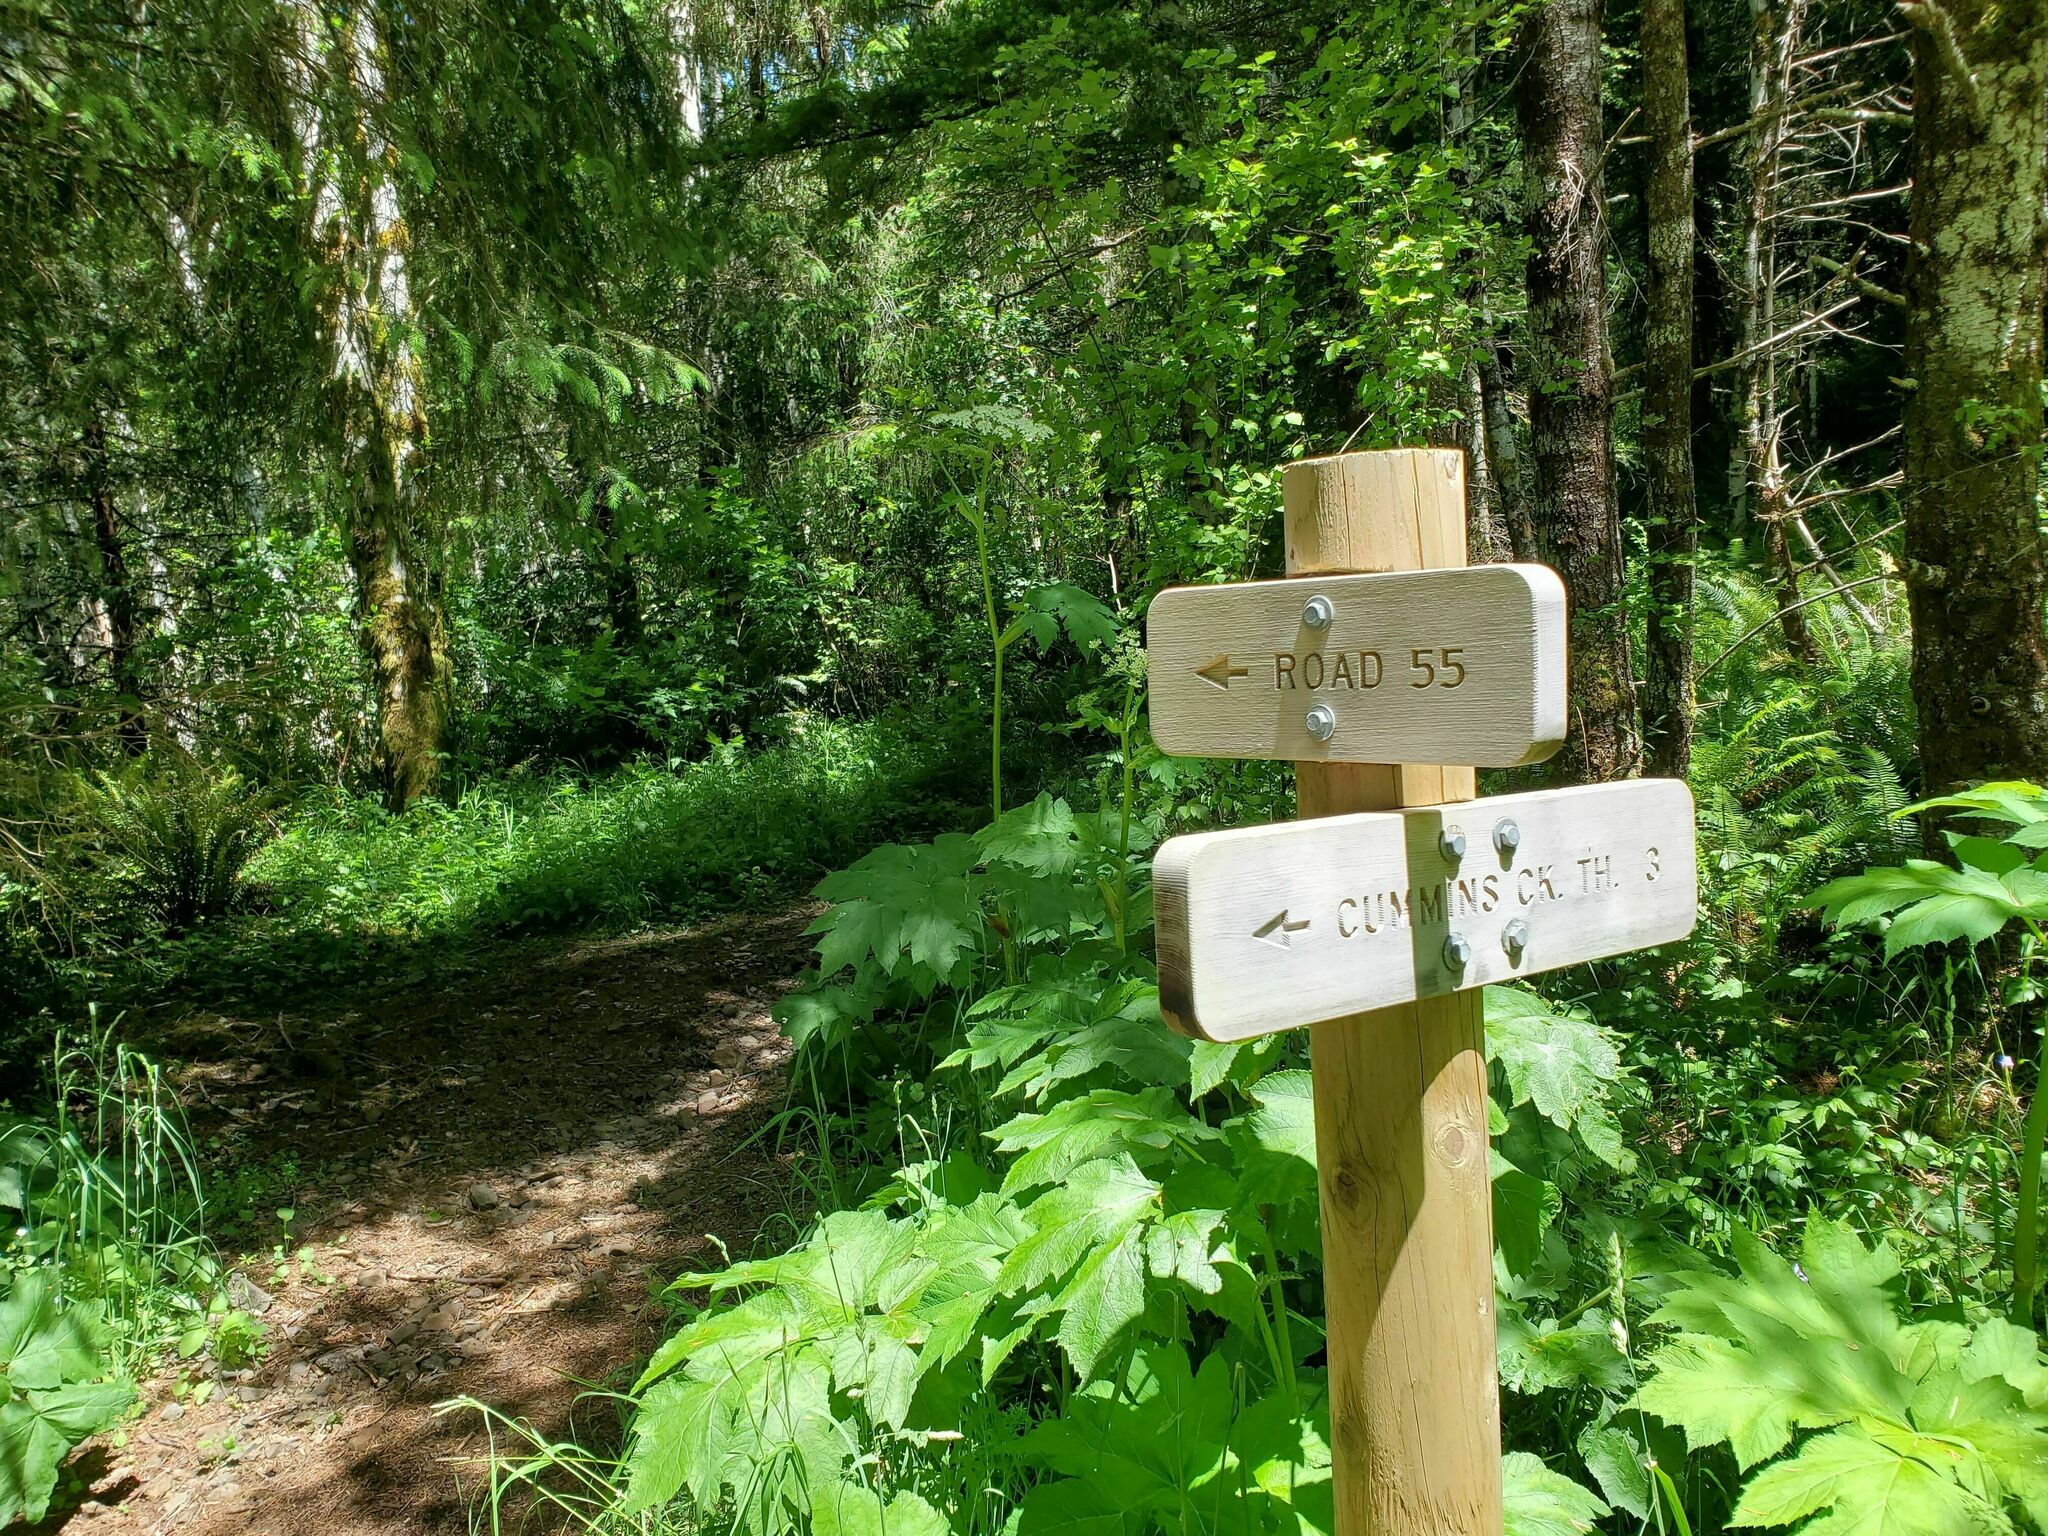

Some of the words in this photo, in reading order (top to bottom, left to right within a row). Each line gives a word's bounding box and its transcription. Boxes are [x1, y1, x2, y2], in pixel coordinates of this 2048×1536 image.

[1274, 651, 1383, 690] ROAD
[1410, 649, 1465, 689] 55
[1338, 874, 1499, 939] CUMMINS
[1517, 865, 1563, 906] CK.
[1577, 855, 1619, 895] TH.
[1646, 847, 1661, 882] 3
